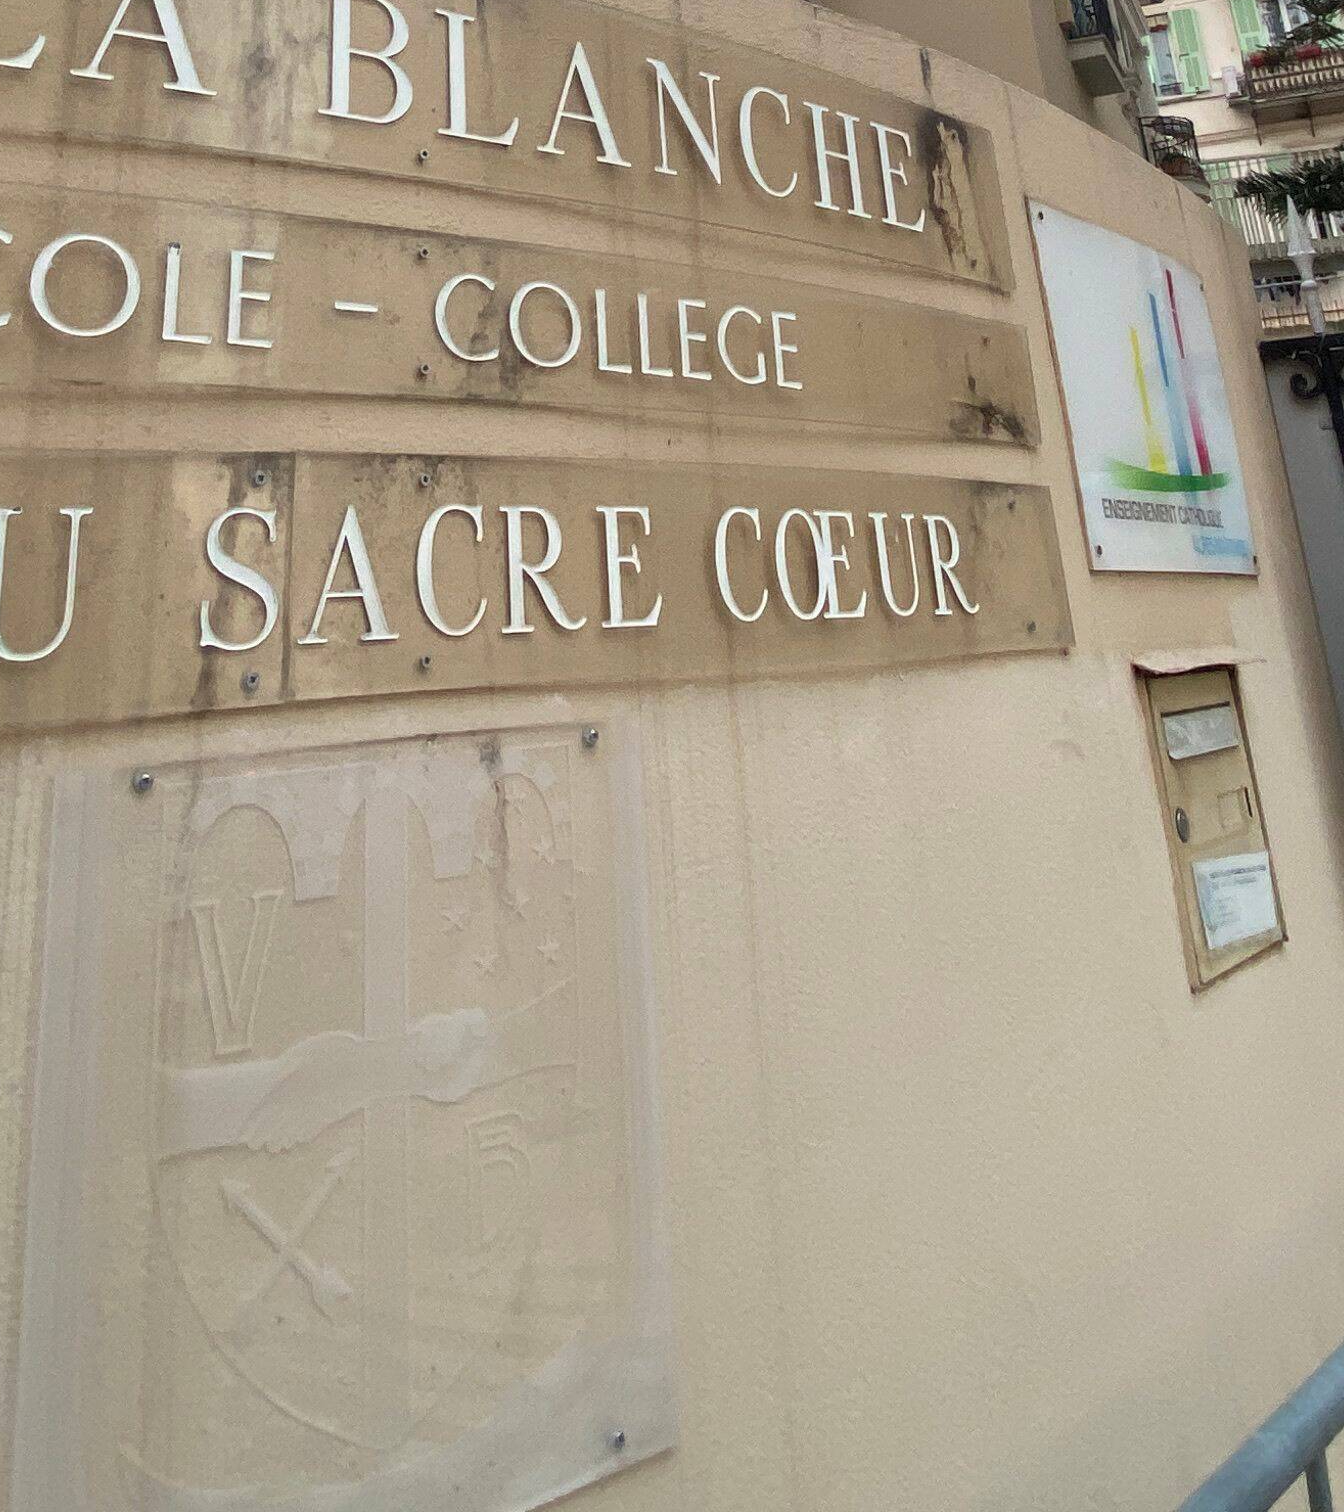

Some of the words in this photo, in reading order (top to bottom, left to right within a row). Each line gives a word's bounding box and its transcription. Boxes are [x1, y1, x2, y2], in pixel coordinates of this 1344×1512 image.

[433, 272, 804, 391] COLLEGE
[1101, 497, 1178, 525] ENSEIGNEMENT
[199, 503, 663, 652] SACRE
